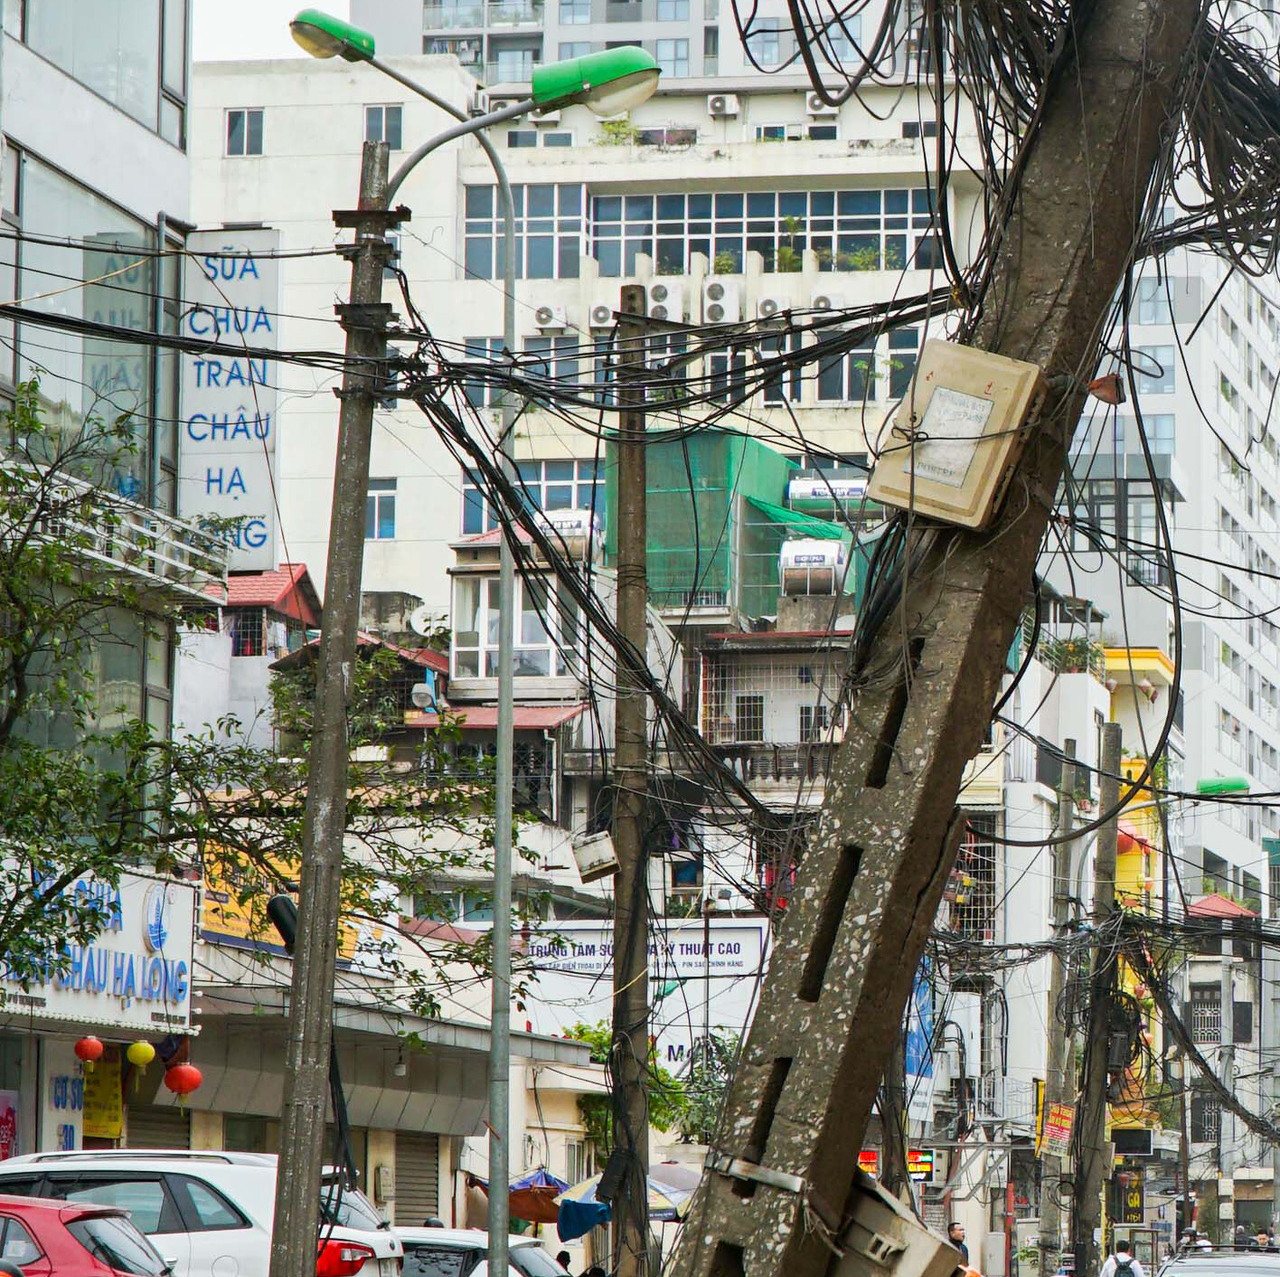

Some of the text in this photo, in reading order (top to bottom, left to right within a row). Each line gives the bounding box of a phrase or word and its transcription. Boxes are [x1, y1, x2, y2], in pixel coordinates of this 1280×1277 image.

[189, 305, 272, 335] CHUA
[187, 406, 271, 440] CHÂU
[206, 467, 247, 500] HẠ
[196, 520, 268, 550] ONG
[718, 942, 741, 955] CAO
[113, 951, 137, 1009] HẠ
[141, 956, 189, 1004] LONG
